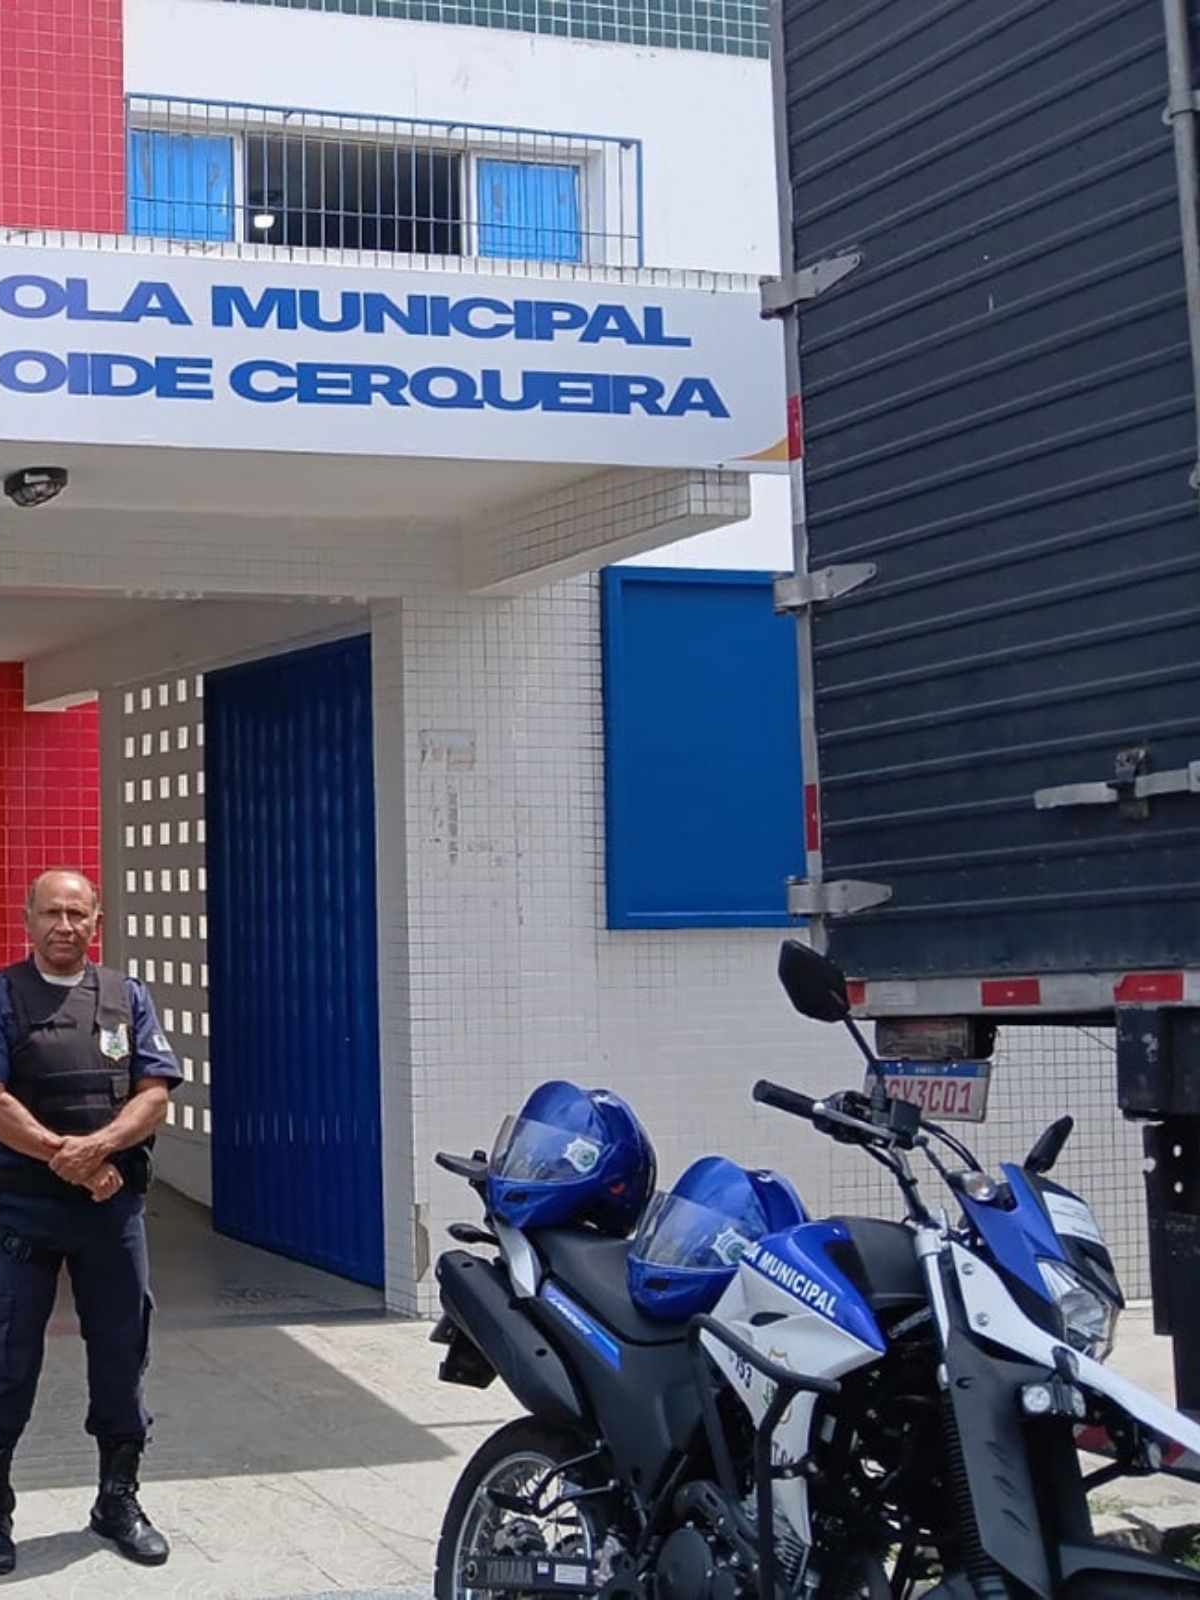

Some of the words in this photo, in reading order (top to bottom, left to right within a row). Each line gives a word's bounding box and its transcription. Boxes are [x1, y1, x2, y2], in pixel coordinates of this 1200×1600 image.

[211, 285, 692, 348] MUNICIPAL
[229, 359, 731, 419] CERQUEIRA
[757, 1251, 837, 1318] MUNICIPAL
